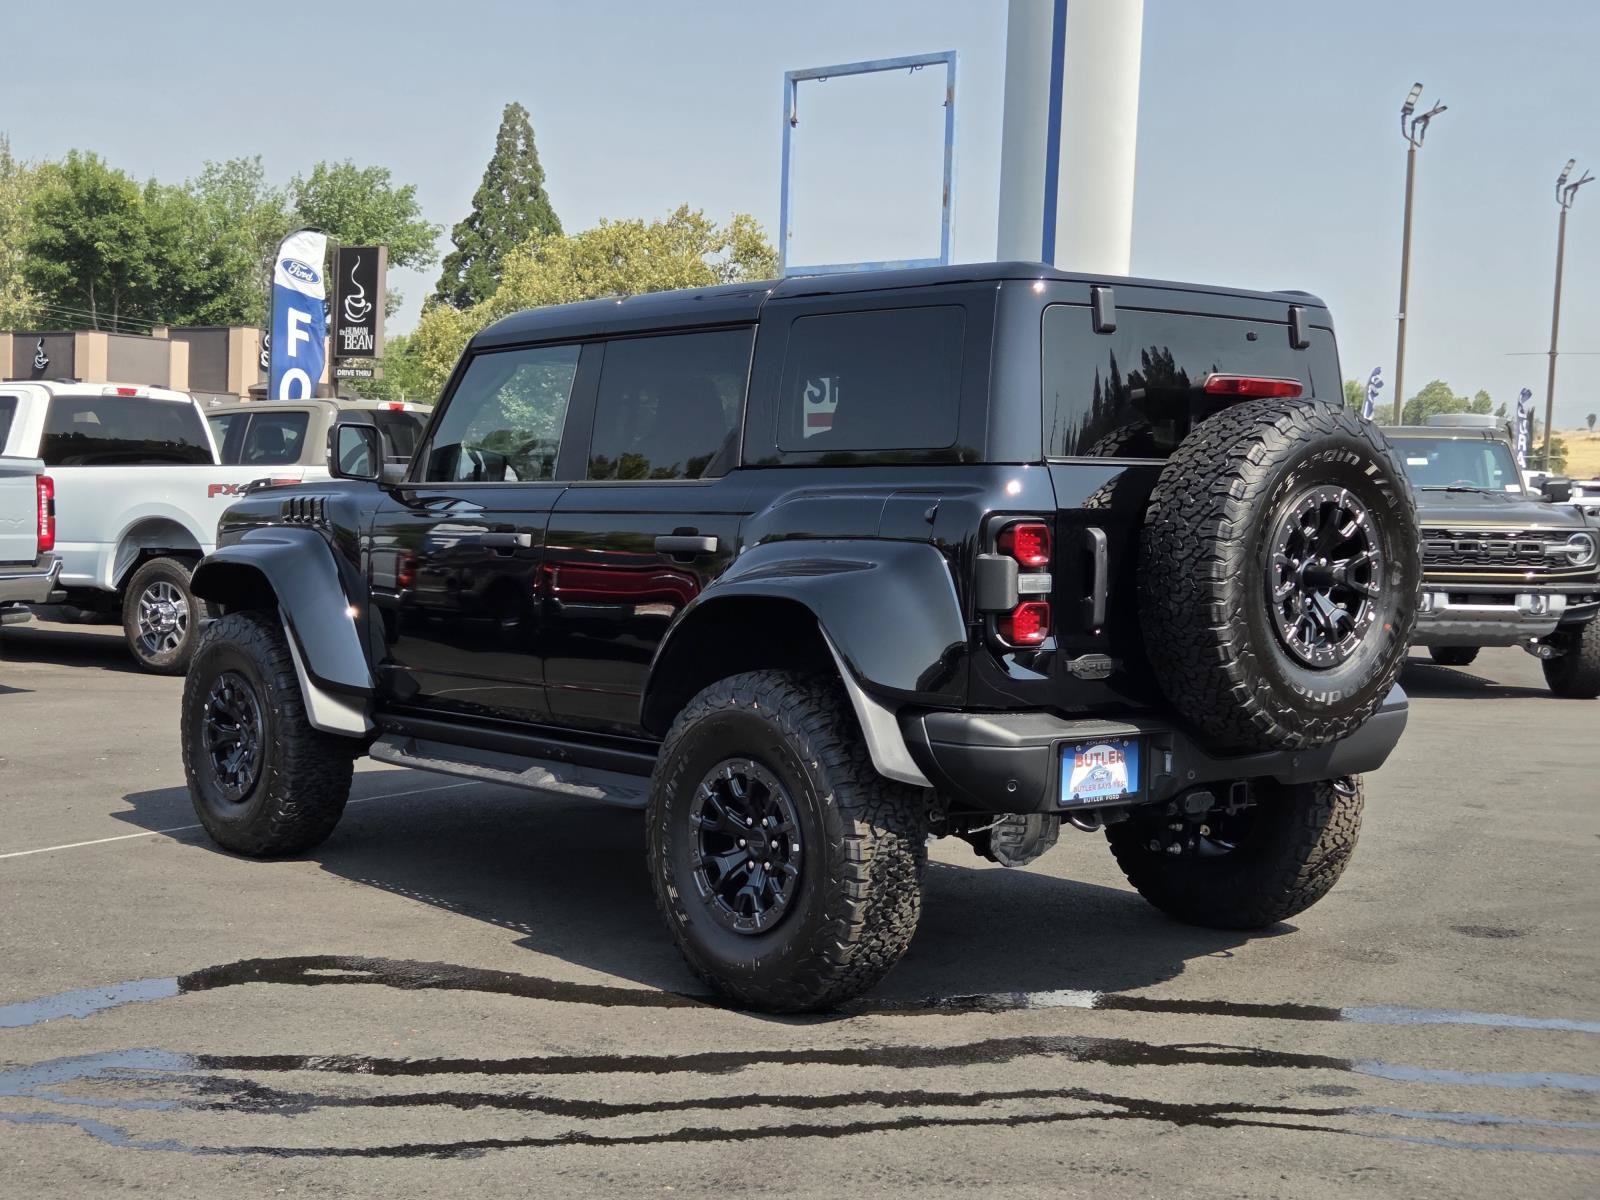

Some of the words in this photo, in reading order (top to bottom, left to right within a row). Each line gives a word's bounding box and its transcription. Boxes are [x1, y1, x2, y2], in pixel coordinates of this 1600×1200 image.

[288, 261, 314, 282] Ford
[345, 326, 369, 335] HUMAN
[343, 334, 374, 350] BEAN
[355, 369, 372, 377] THRU
[1075, 750, 1124, 769] BUTLER
[1073, 783, 1096, 793] BUTLER
[1097, 782, 1112, 790] SAYS
[1083, 796, 1104, 804] BUTLER
[1105, 793, 1120, 801] FORD
